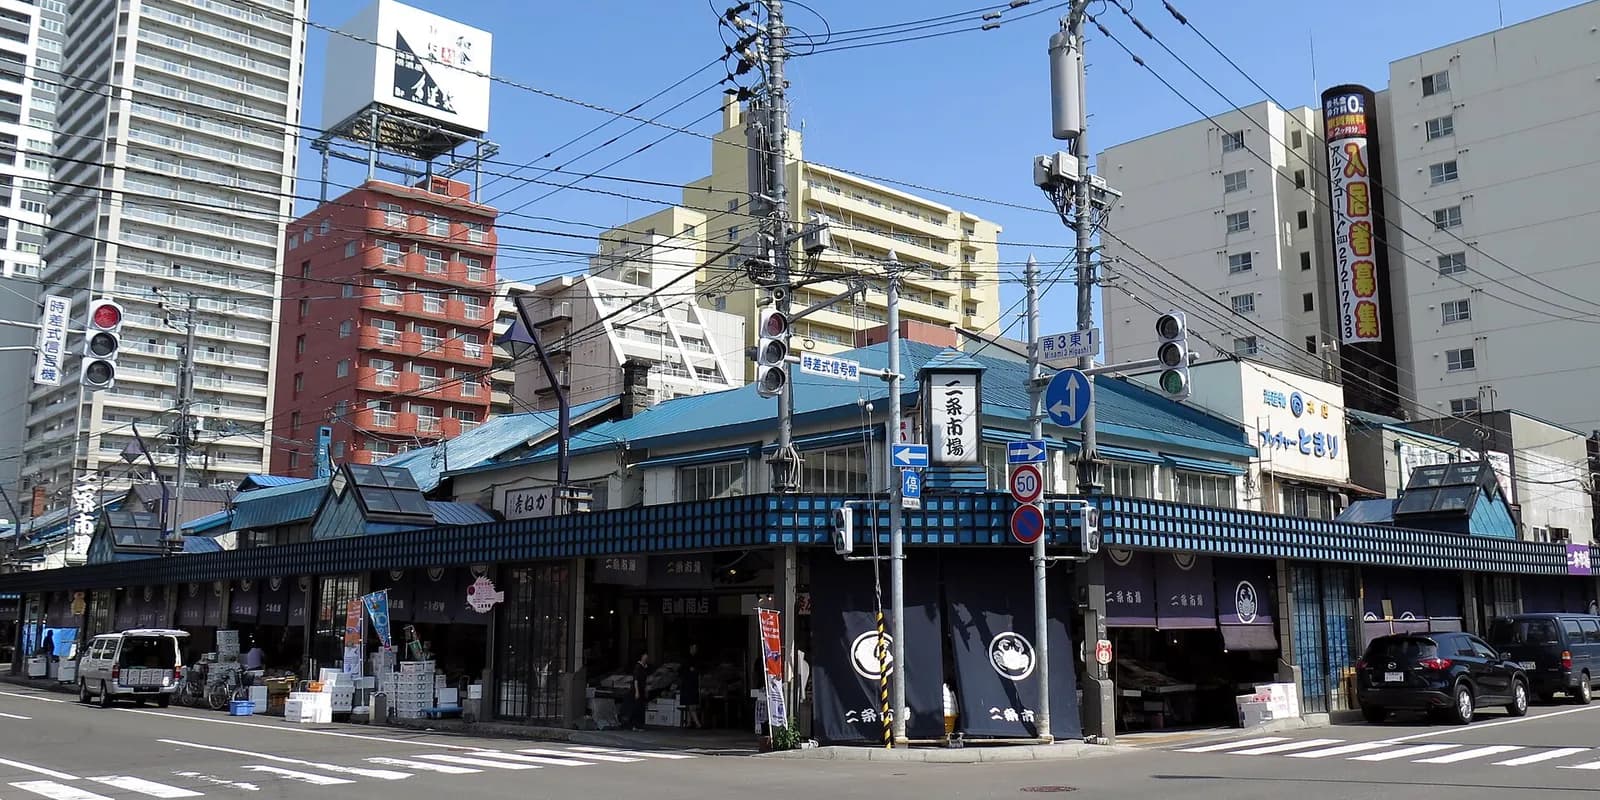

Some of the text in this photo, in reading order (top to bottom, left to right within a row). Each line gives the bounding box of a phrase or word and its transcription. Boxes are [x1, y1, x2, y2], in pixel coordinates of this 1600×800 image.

[1330, 145, 1344, 221] アルファコート
[1344, 142, 1379, 338] 入居募集
[40, 299, 66, 382] 時差式信号機
[803, 356, 857, 378] 時差式信号機
[945, 380, 963, 456] 二条市場
[904, 475, 918, 493] 停
[1017, 475, 1035, 492] 50
